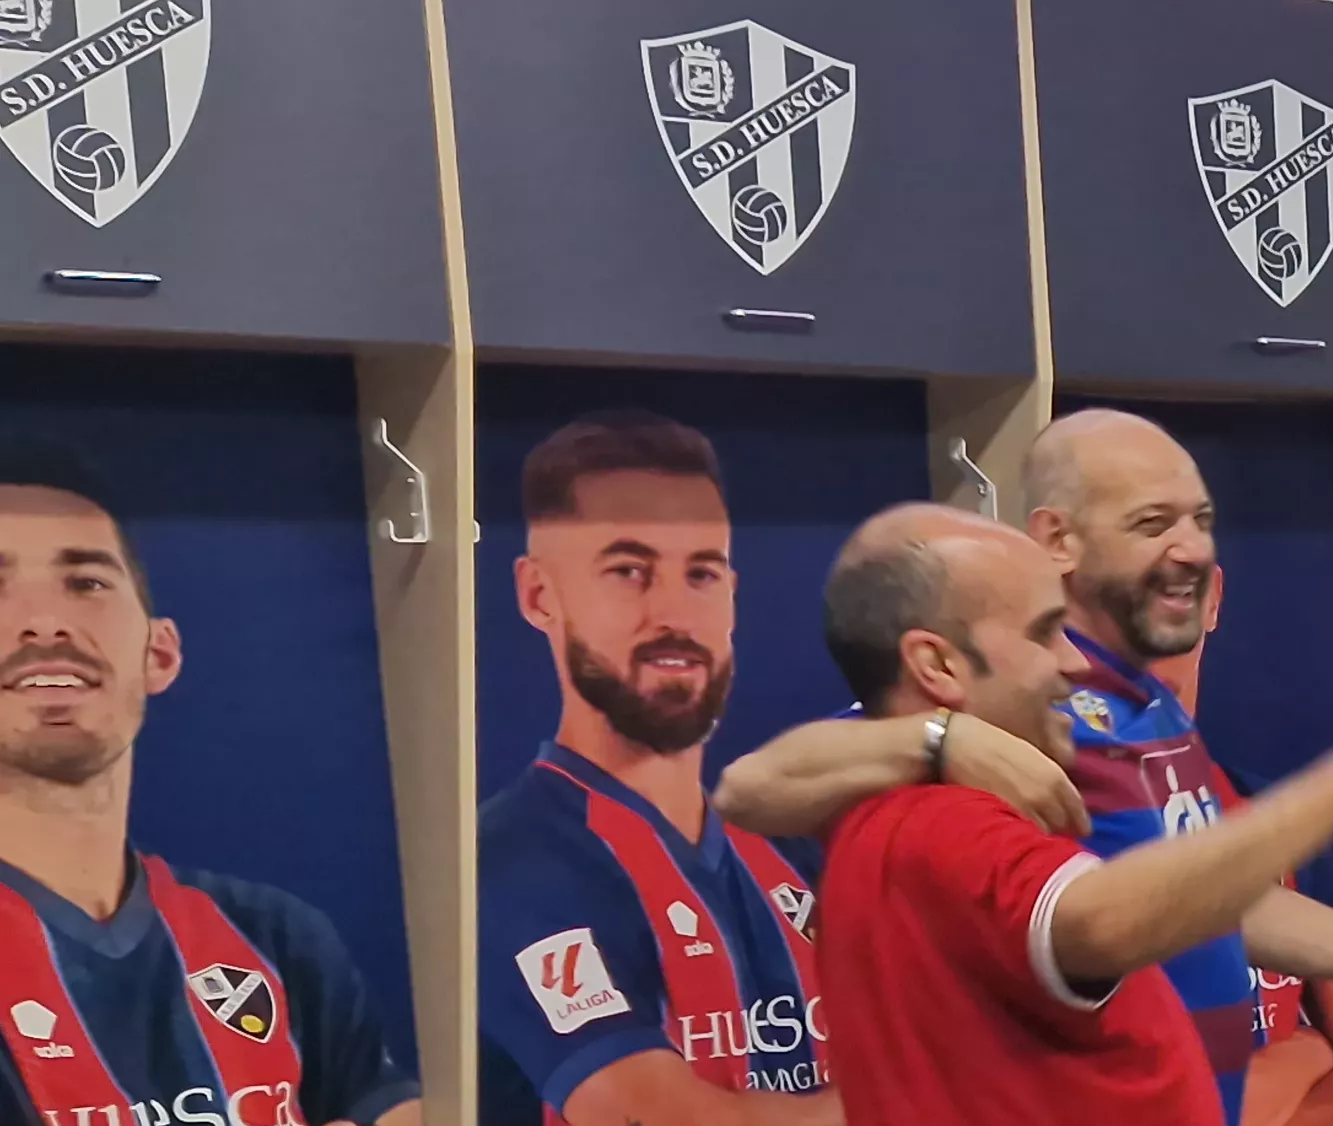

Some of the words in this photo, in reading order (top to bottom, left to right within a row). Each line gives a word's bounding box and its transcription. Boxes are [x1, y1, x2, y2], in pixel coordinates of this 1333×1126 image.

[1, 74, 67, 116] S.D.
[60, 1, 195, 82] HUESCA
[691, 140, 744, 178] S.D.
[739, 75, 843, 147] HUESCA
[1227, 188, 1269, 221] S.D.
[555, 989, 615, 1020] LALIGA
